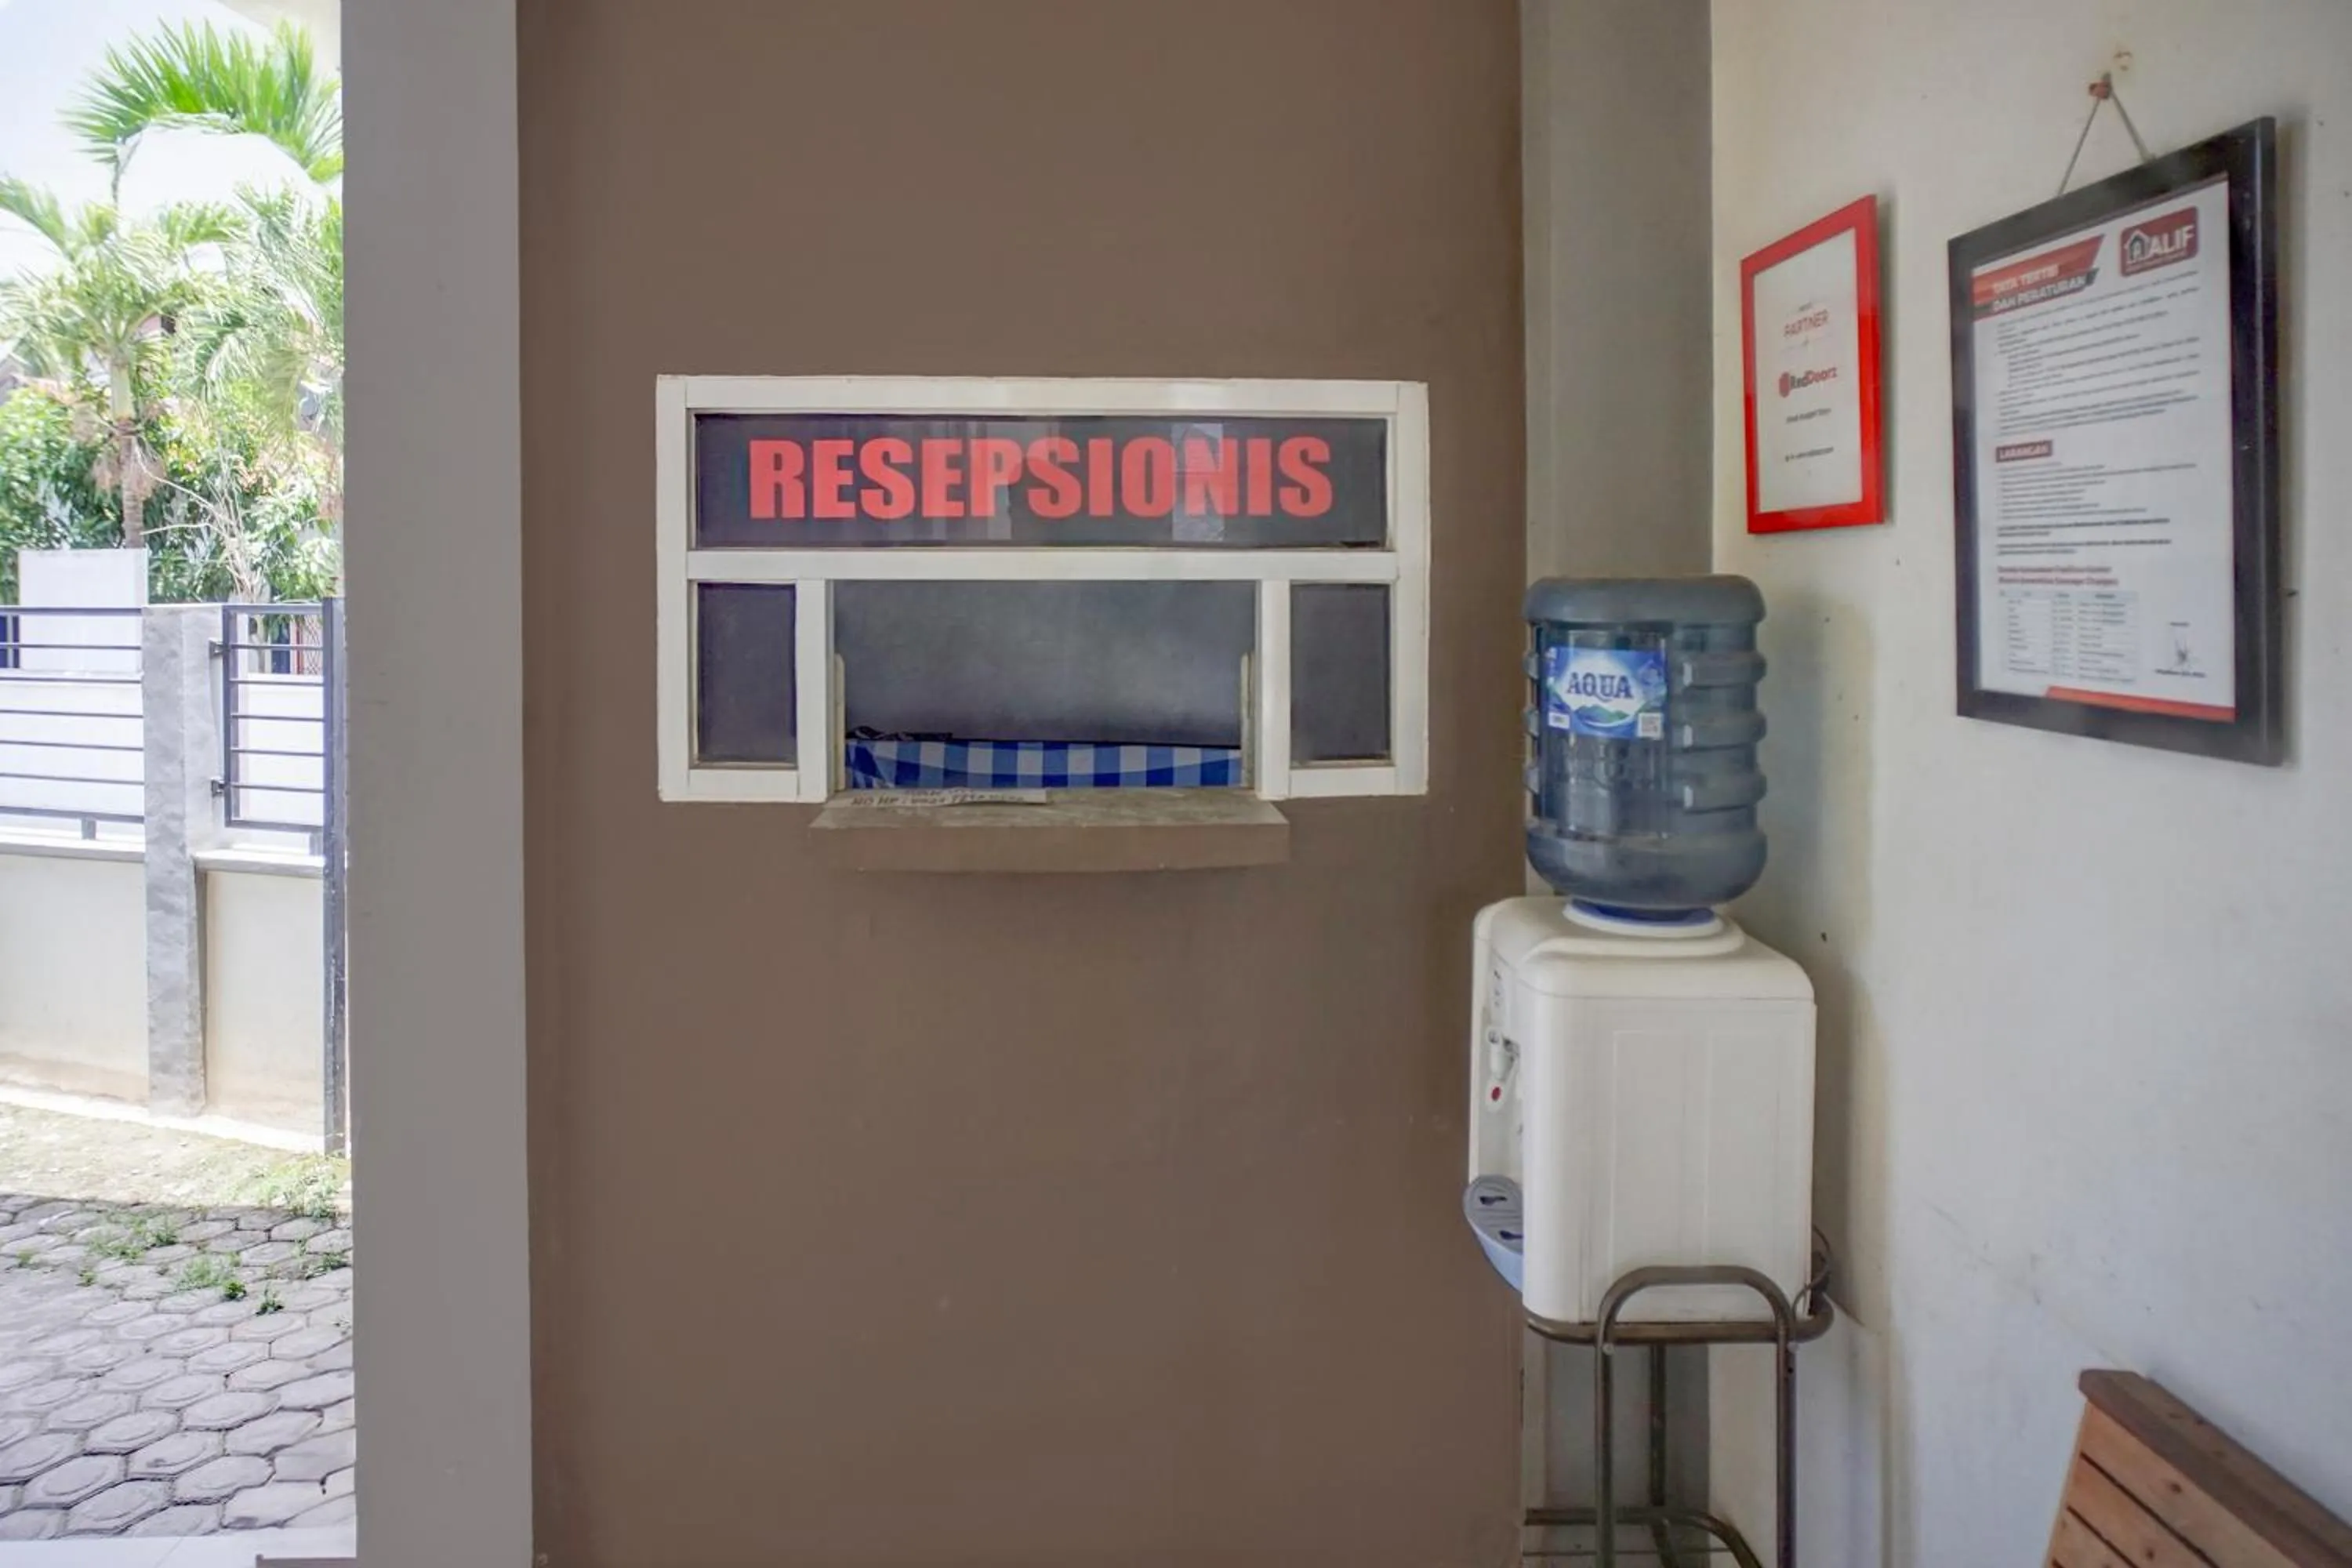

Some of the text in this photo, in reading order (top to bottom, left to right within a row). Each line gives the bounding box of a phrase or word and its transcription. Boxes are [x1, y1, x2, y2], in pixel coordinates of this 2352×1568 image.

[2148, 224, 2195, 258] ALIF
[748, 436, 1334, 521] RESEPSIONIS
[1566, 671, 1634, 703] AQUA
